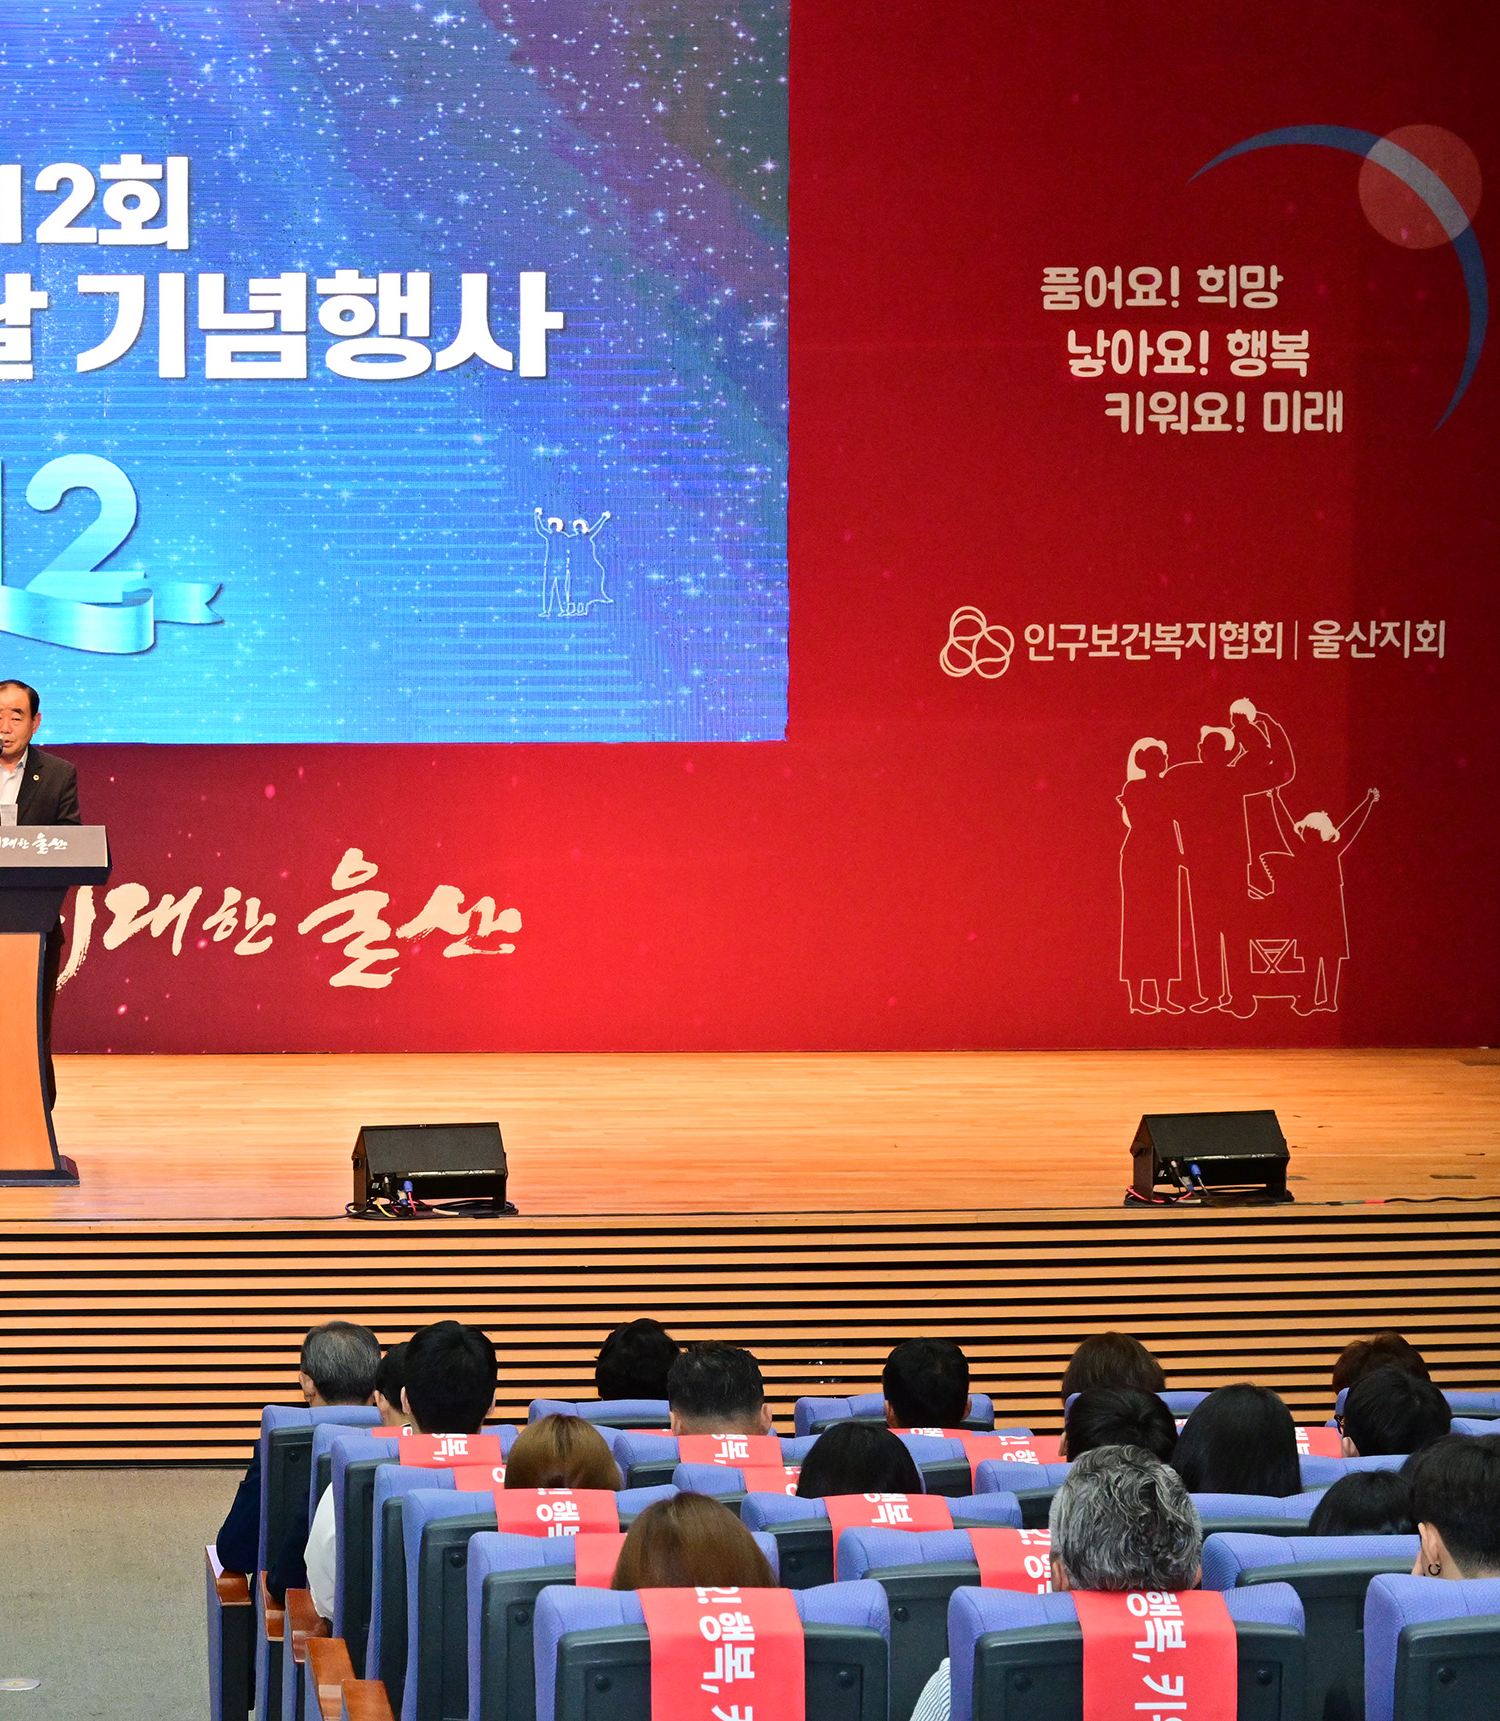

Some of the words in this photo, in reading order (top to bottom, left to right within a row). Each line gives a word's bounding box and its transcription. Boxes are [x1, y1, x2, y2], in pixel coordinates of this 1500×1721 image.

[1041, 265, 1180, 310] 품어요!
[1197, 265, 1284, 309] 희망
[76, 270, 564, 380] 기념행사
[1067, 329, 1209, 377] 낳아요!
[1227, 329, 1310, 377] 행복
[1104, 391, 1246, 435] 키워요!
[1263, 390, 1344, 434] 미래
[1024, 621, 1284, 661] 인구보건복지협회
[1308, 619, 1446, 660] 울산지회
[297, 847, 523, 989] 울산
